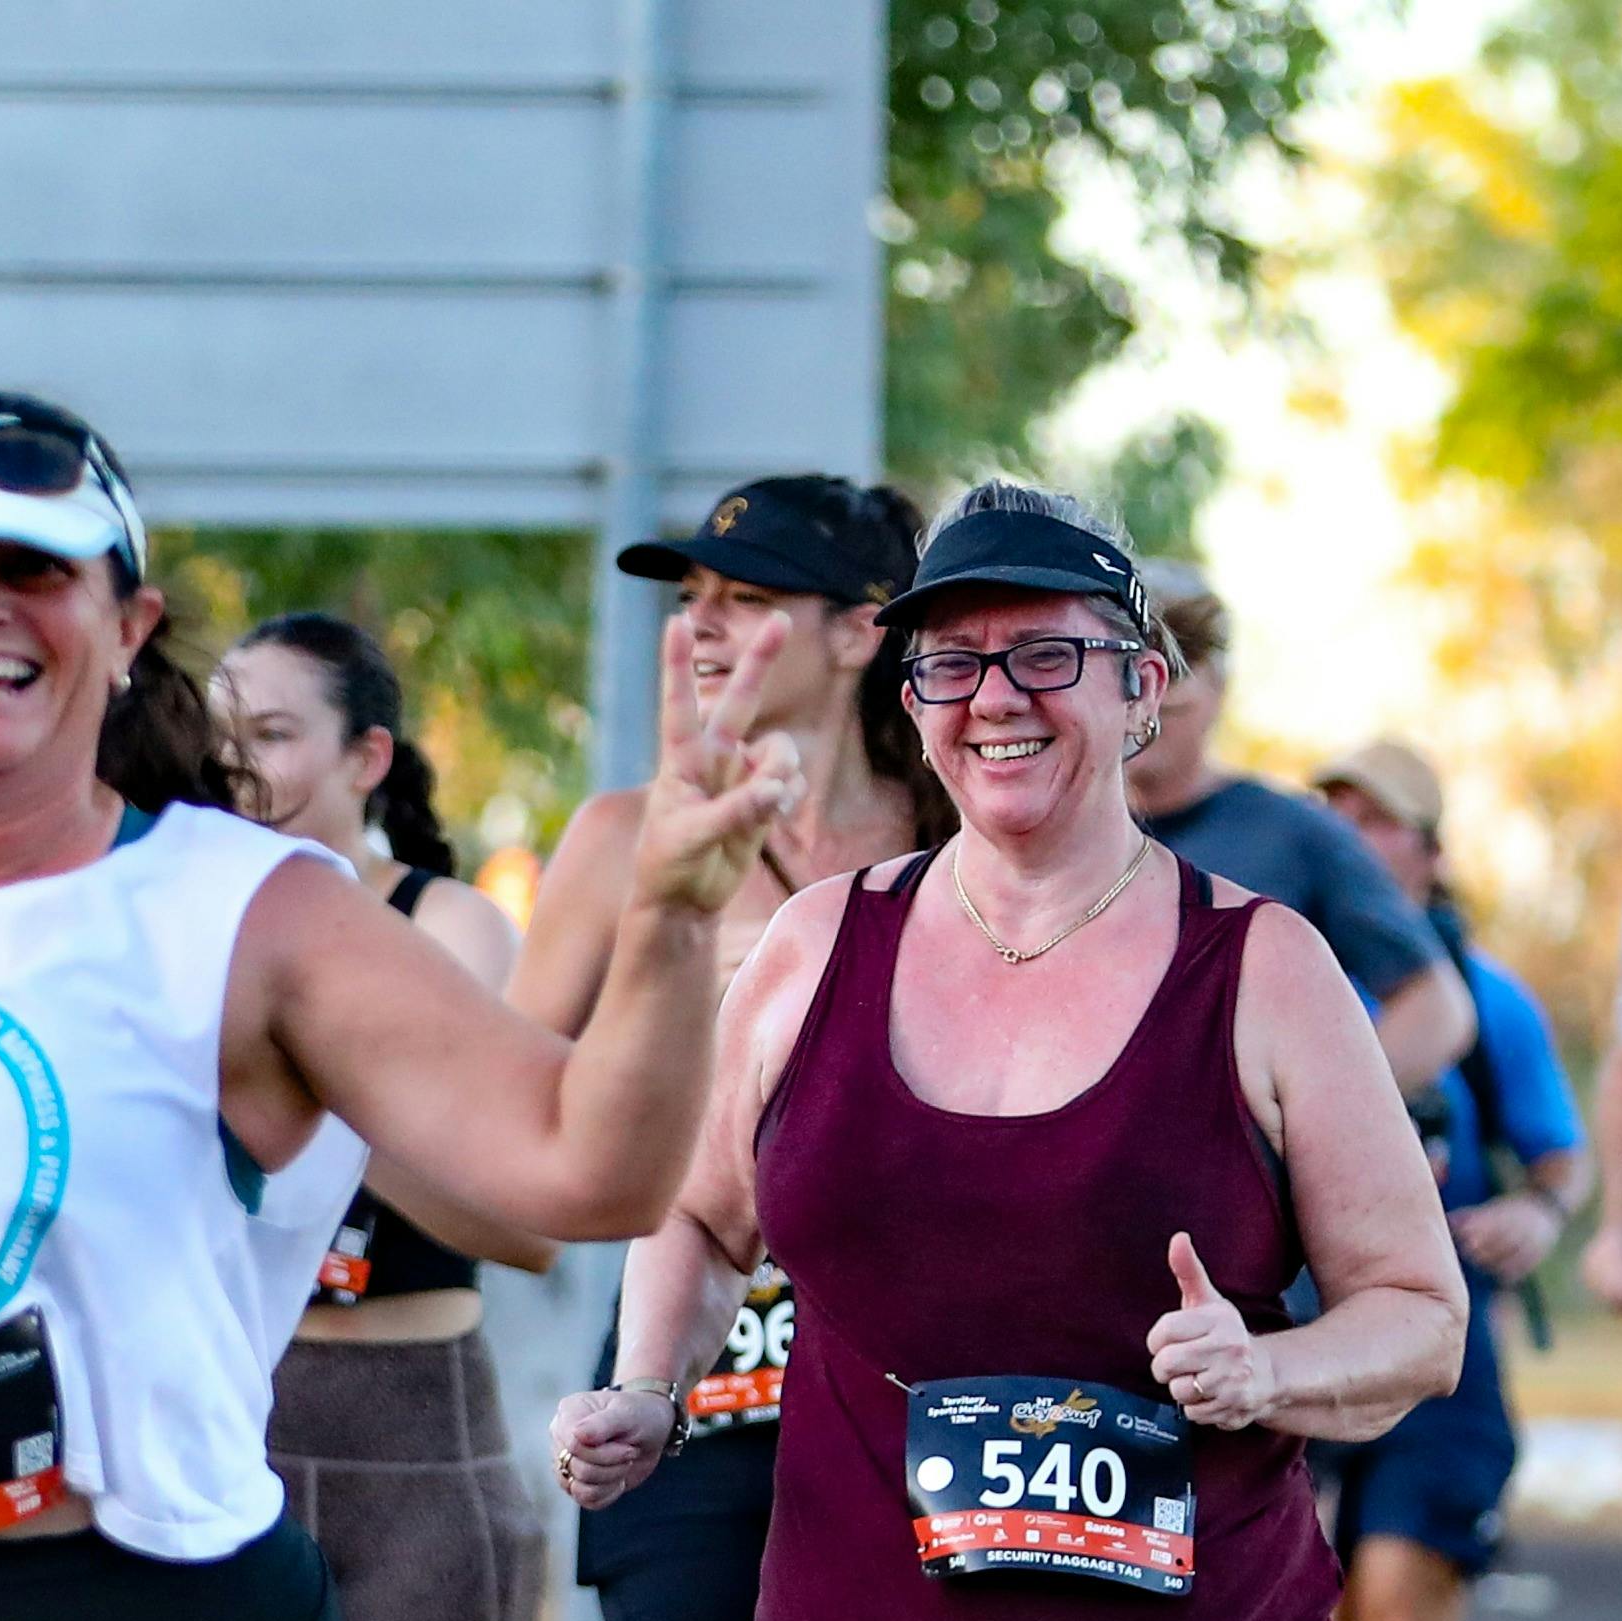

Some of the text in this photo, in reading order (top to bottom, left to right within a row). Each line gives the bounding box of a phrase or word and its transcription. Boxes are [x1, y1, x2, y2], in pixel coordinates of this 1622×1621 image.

[979, 1439, 1126, 1517] 540
[987, 1551, 1051, 1564] SECURITY
[1052, 1554, 1115, 1573] BAGGAGE
[1118, 1564, 1142, 1579] TAG
[1164, 1577, 1183, 1589] 540
